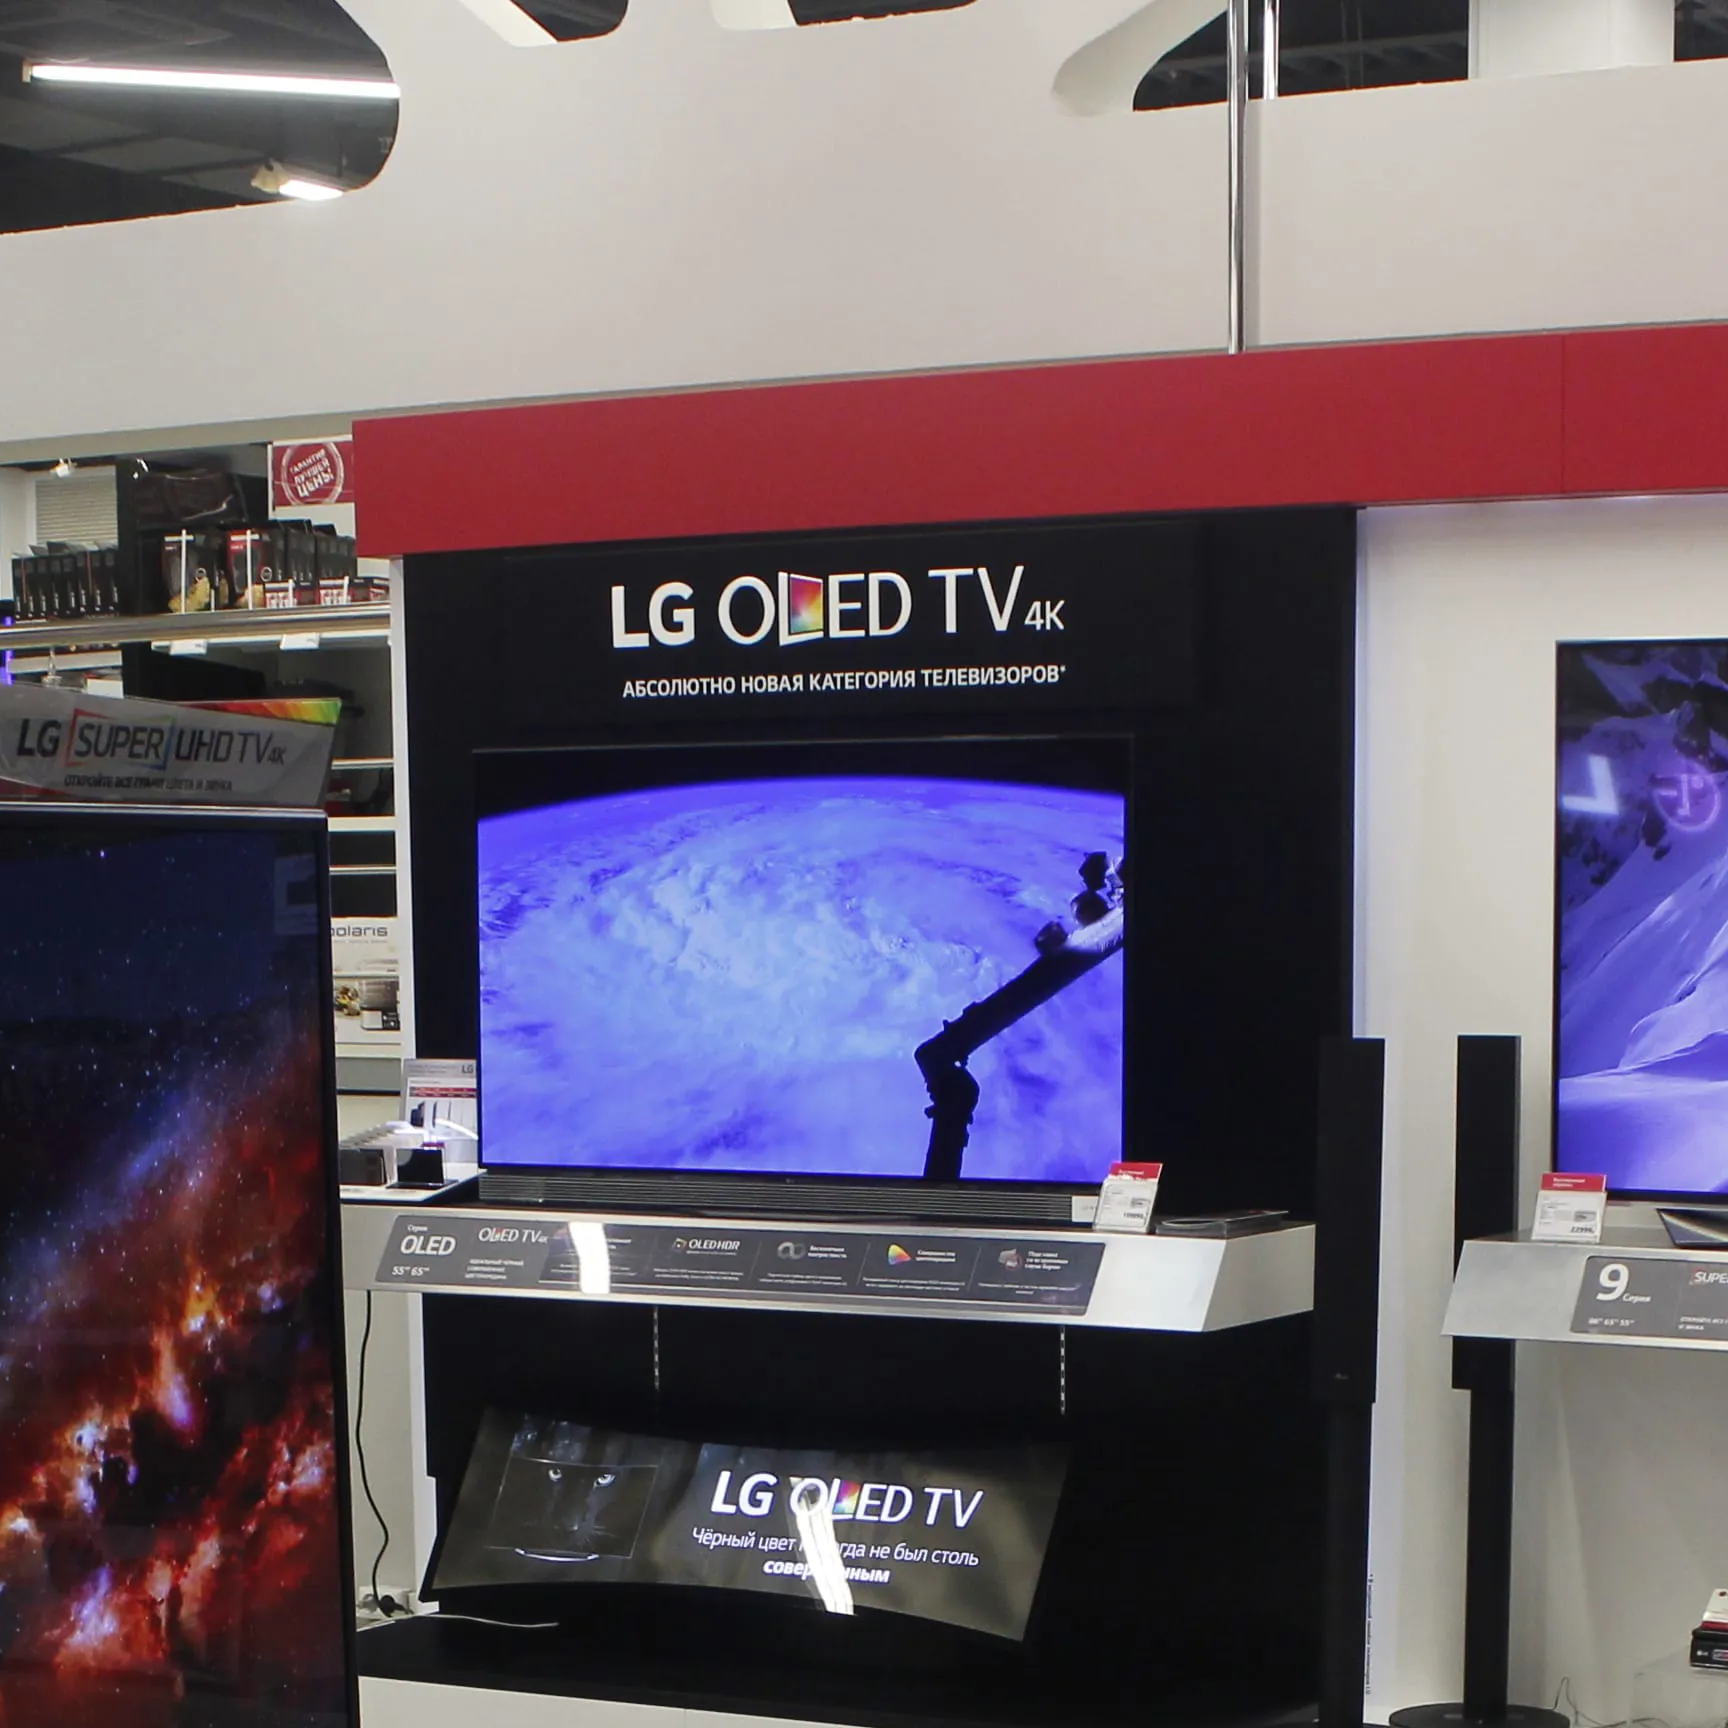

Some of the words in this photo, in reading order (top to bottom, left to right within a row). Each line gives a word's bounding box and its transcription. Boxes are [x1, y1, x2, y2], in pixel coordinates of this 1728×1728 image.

[611, 582, 695, 648] LG
[718, 571, 912, 646] OLED
[622, 674, 736, 698] АБСОЛЮТНО
[741, 673, 804, 694] НОВАЯ
[810, 669, 916, 692] КАТЕГОРИЯ
[16, 719, 62, 758] LG
[74, 722, 165, 760] SUPER
[174, 728, 235, 763] UHD
[461, 1064, 474, 1074] LG
[400, 1235, 457, 1256] OLED
[478, 1227, 520, 1242] OLED
[1596, 1262, 1630, 1301] 9
[1622, 1292, 1652, 1303] Серия
[711, 1471, 778, 1517] LG
[789, 1477, 913, 1522] OLED
[924, 1487, 984, 1527] TV
[692, 1527, 756, 1549] Чёрный
[758, 1536, 796, 1552] цвет
[869, 1544, 890, 1558] не
[893, 1543, 927, 1562] был
[931, 1550, 980, 1566] столь
